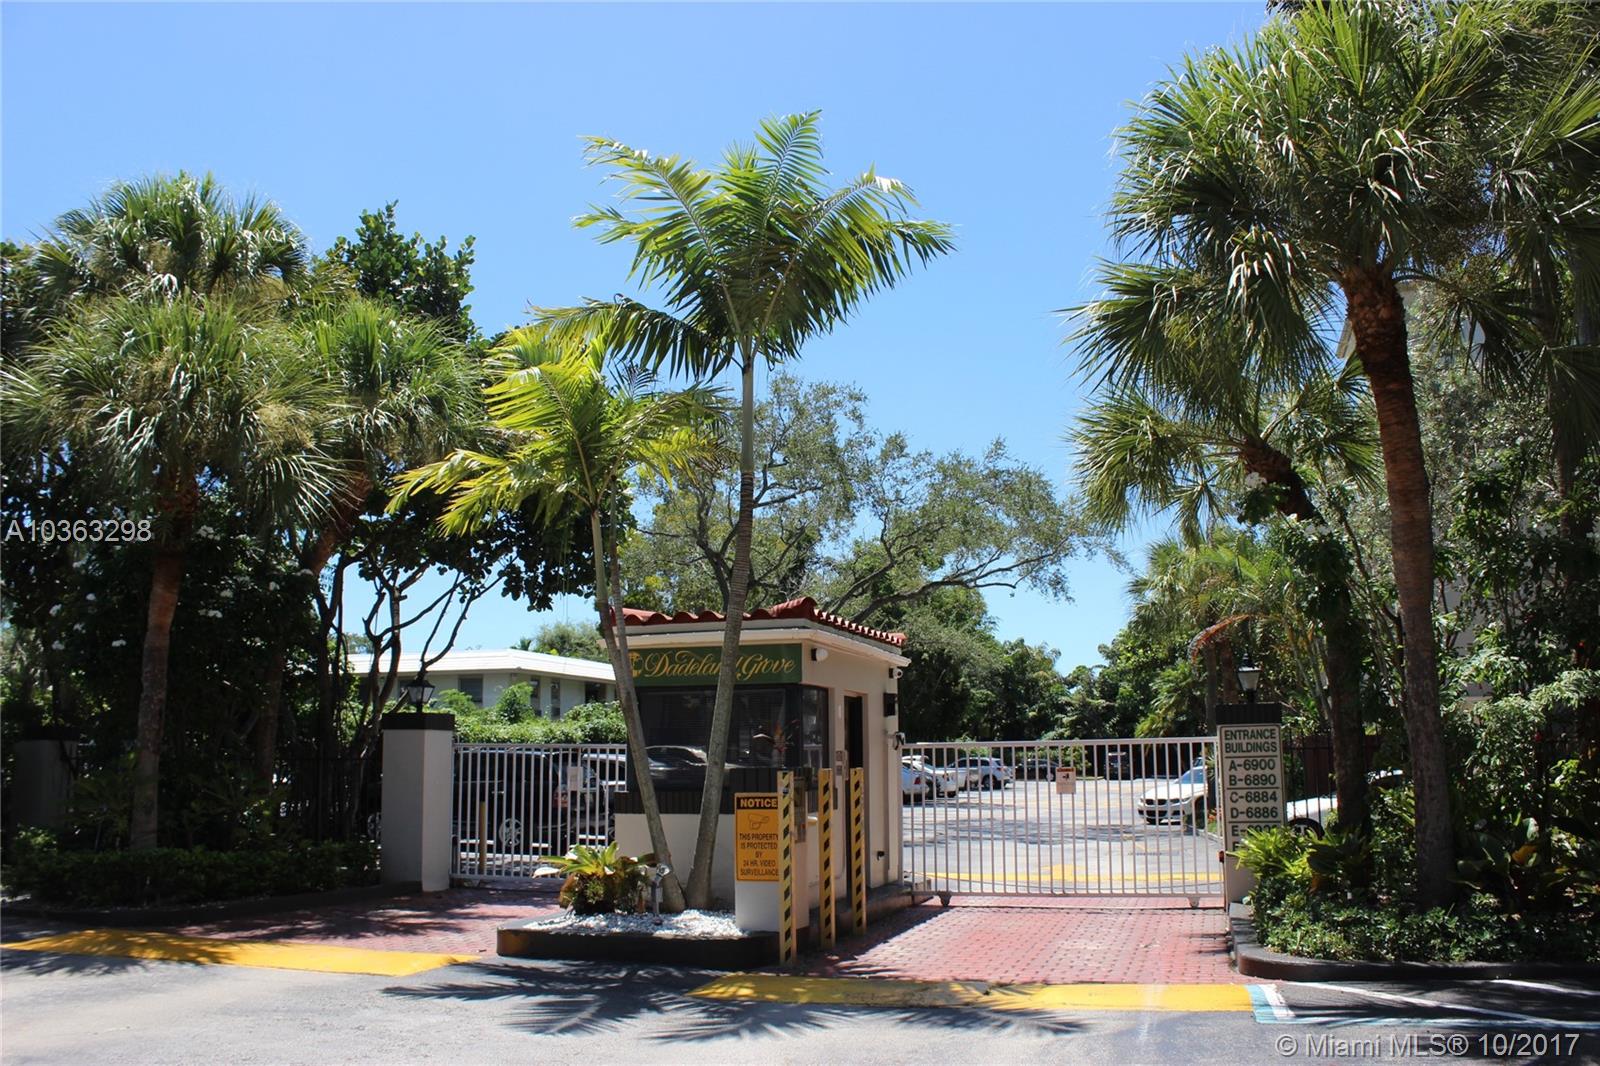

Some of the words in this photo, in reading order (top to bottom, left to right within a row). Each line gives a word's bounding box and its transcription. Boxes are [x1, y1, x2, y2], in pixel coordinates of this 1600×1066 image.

[736, 654, 796, 681] Grove
[1224, 728, 1276, 741] ENTRANCE
[1225, 741, 1278, 754] BUILDINGS
[1228, 759, 1276, 772] A-6900
[1229, 774, 1277, 786] B-6890
[740, 798, 778, 808] NOTICE
[1229, 791, 1278, 803] C-6884
[1230, 807, 1279, 819] D-6886
[739, 833, 751, 841] THIS
[751, 833, 779, 841] PROPERTY
[741, 842, 746, 850] IS
[747, 842, 778, 850] PROTECTED
[760, 859, 776, 867] VIDEO
[740, 868, 779, 877] SURVEILLANCE
